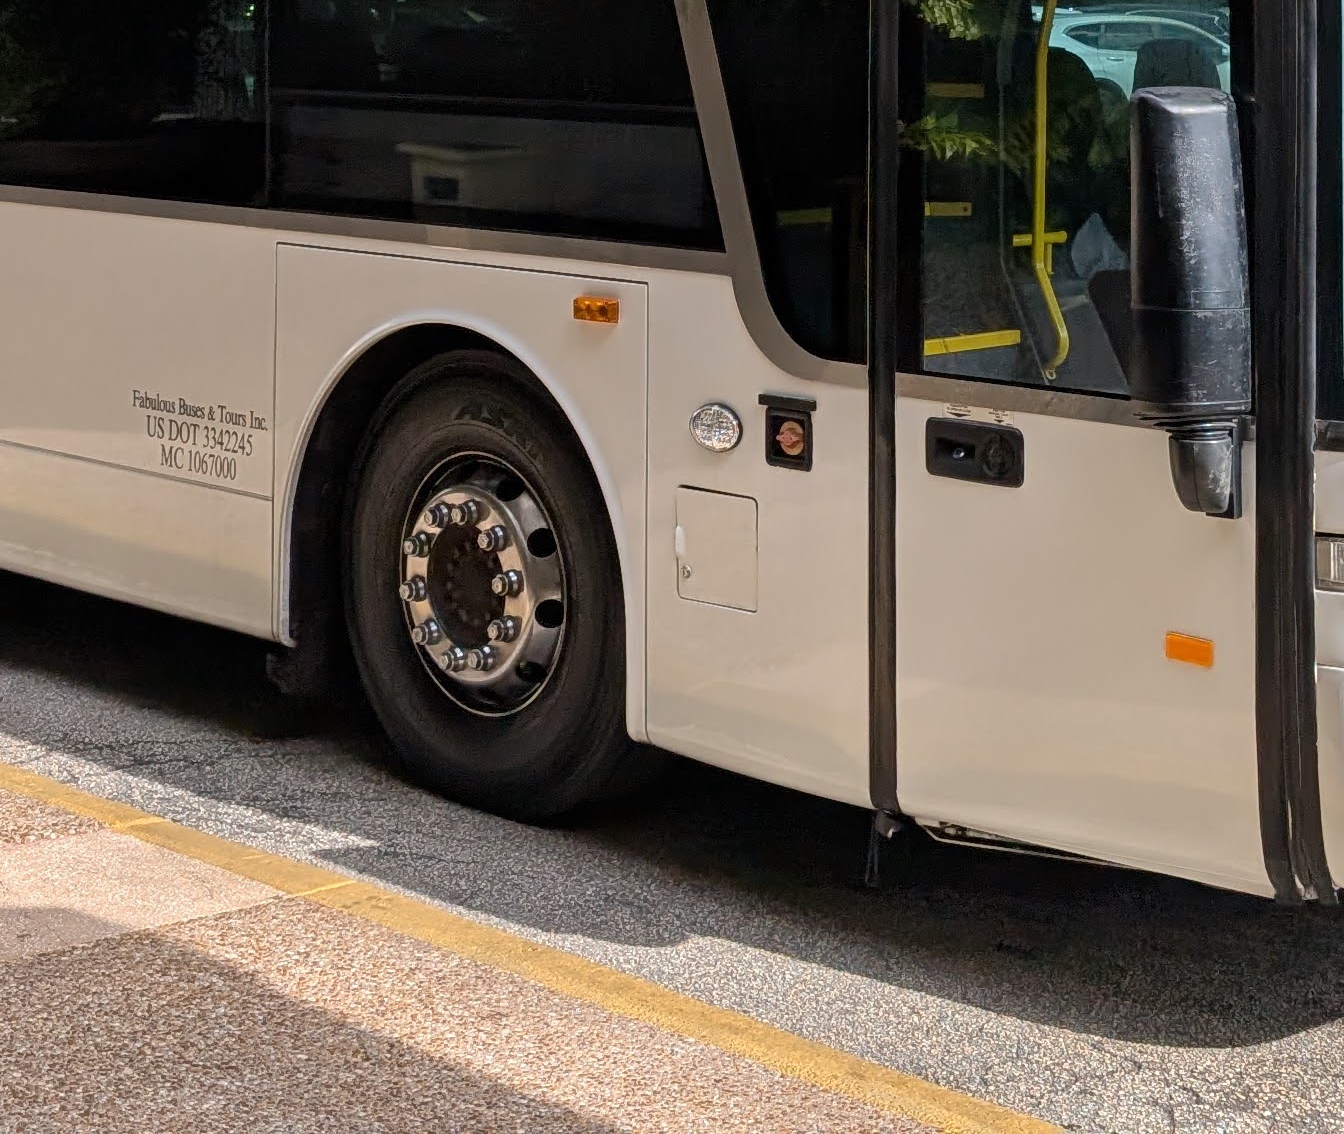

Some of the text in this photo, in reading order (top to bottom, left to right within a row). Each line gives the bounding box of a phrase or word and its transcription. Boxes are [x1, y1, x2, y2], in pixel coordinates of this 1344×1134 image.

[132, 389, 268, 432] Fabulous Buses & Tours Inc.
[146, 415, 254, 457] US DOT 3342245
[160, 443, 237, 481] MC 1067000
